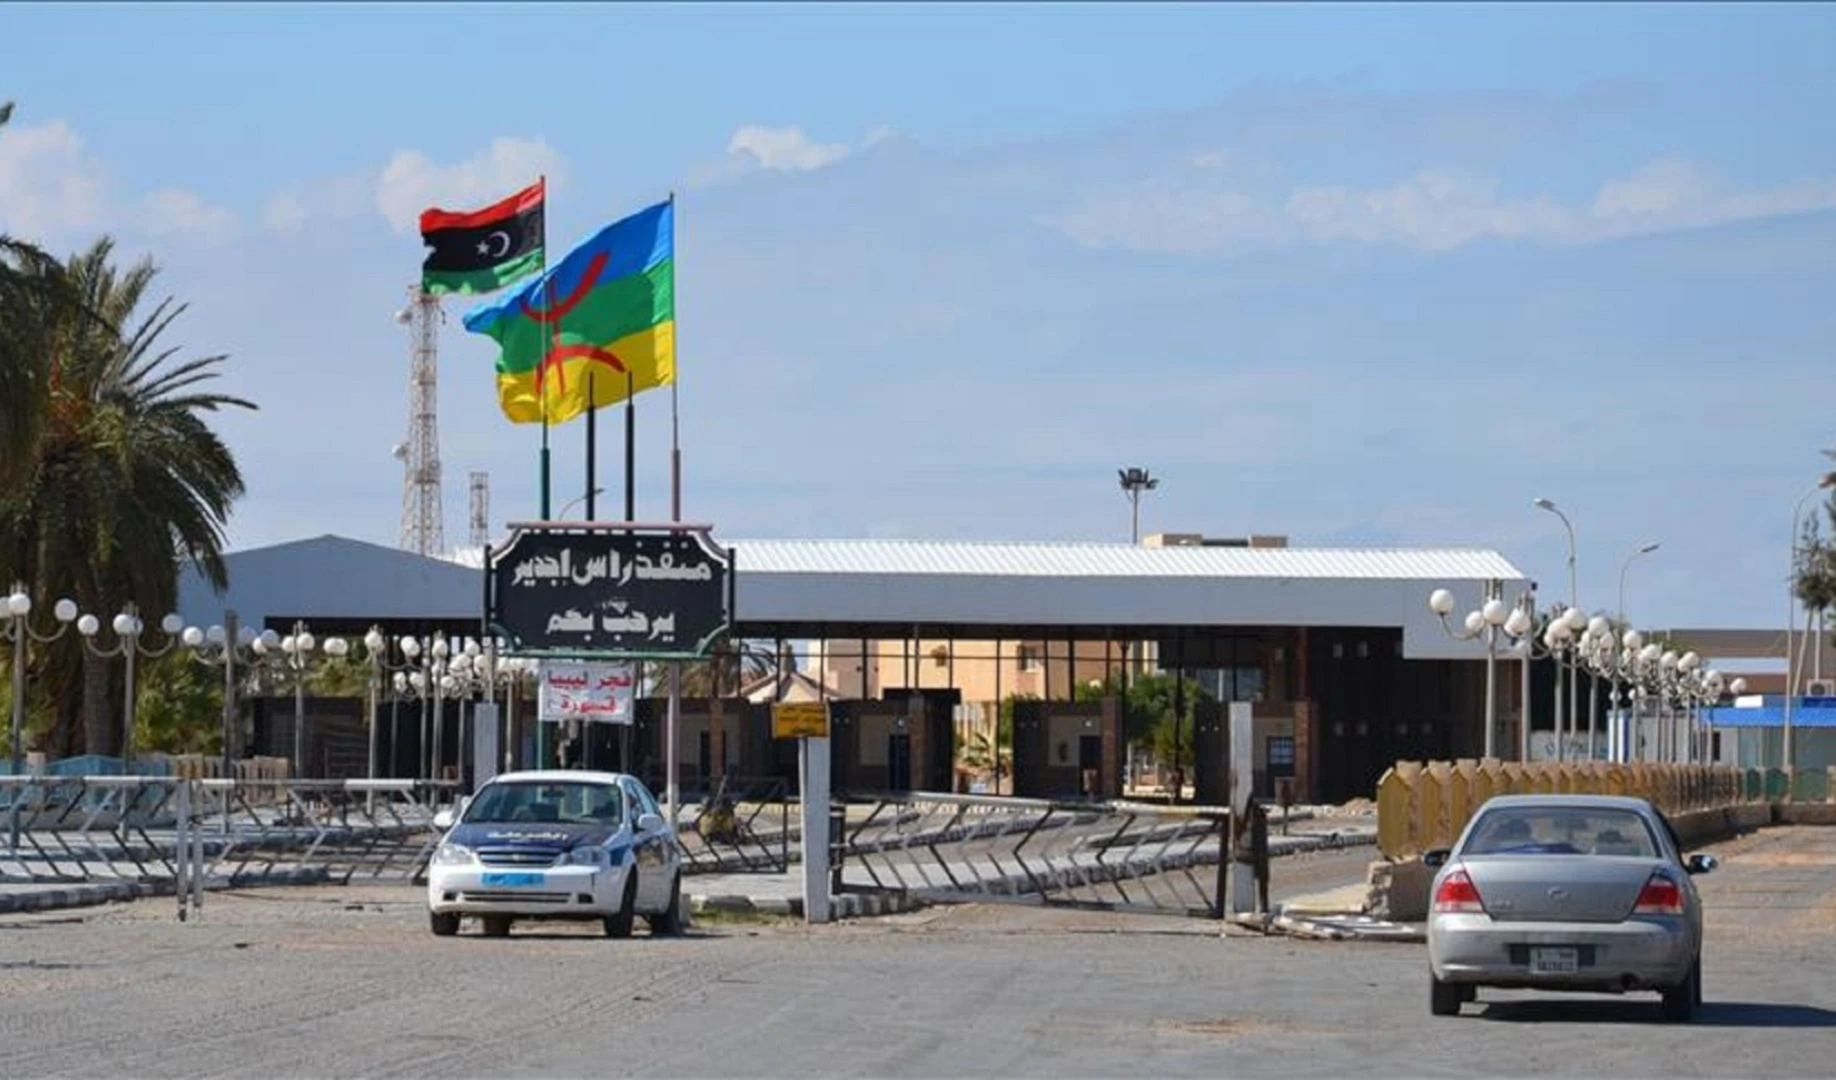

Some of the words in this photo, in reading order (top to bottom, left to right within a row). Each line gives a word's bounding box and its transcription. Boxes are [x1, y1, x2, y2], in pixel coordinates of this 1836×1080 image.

[635, 541, 712, 580] منفذ
[545, 608, 594, 641] بكم
[547, 669, 588, 689] ليبيا
